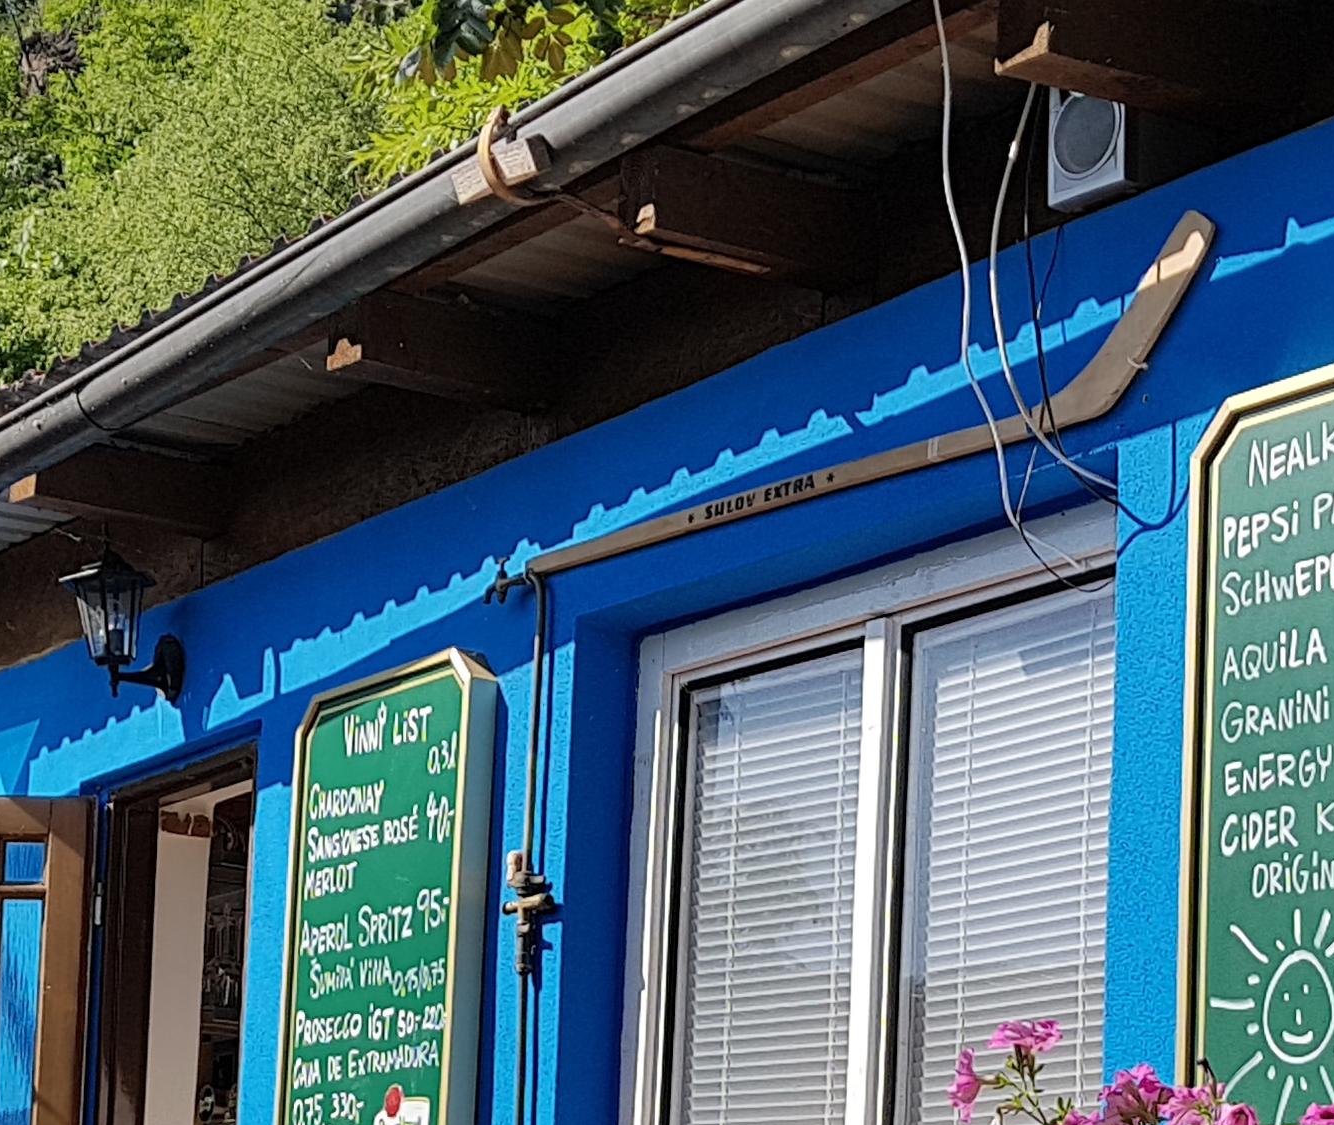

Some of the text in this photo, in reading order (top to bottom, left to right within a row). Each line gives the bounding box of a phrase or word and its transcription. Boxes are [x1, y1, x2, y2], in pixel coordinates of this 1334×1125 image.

[764, 474, 816, 503] EXTRA
[1223, 744, 1334, 797] ENERGY
[304, 861, 357, 900] MERLOT
[300, 914, 352, 956] APEROL
[295, 1010, 363, 1048] PROSECCO
[327, 1055, 343, 1082] DE
